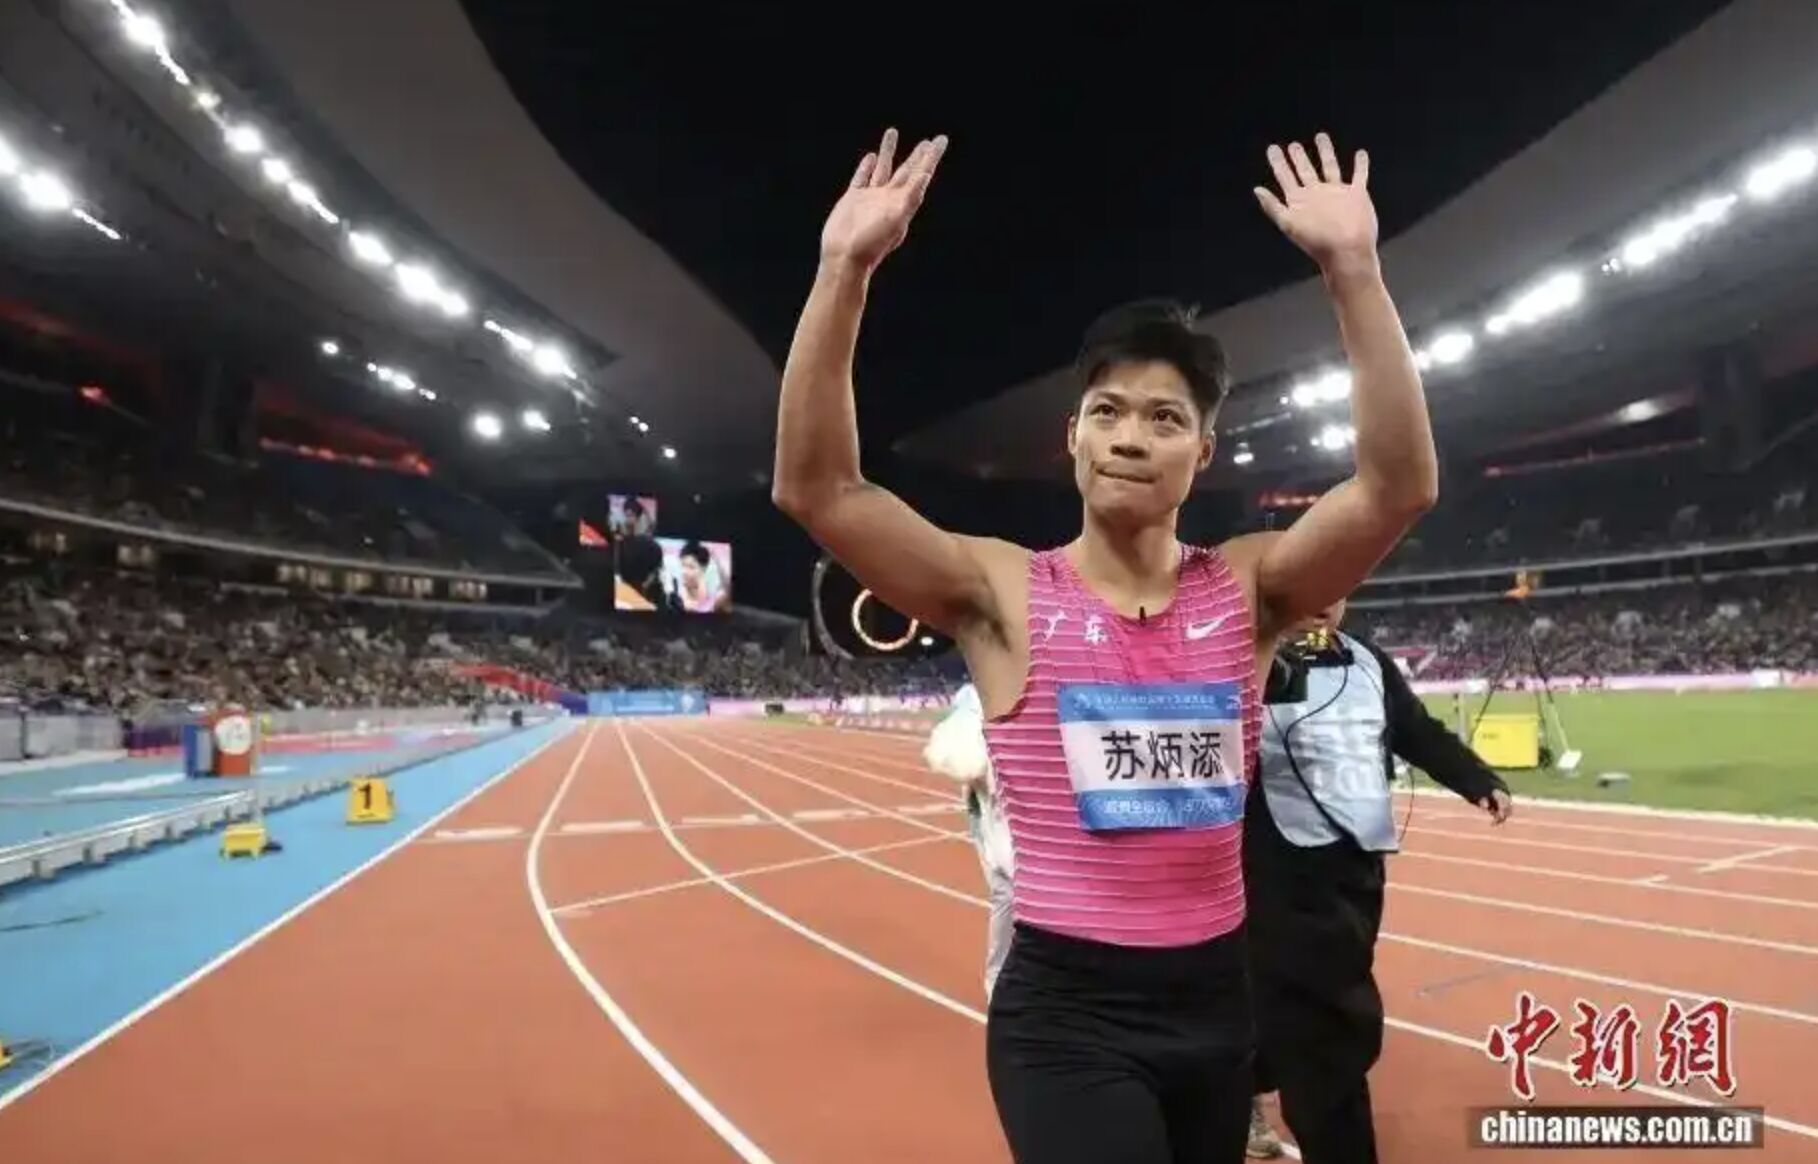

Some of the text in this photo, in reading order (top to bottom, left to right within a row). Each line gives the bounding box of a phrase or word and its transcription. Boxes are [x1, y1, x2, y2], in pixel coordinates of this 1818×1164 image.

[1101, 730, 1224, 781] 苏炳添
[358, 783, 372, 810] 1
